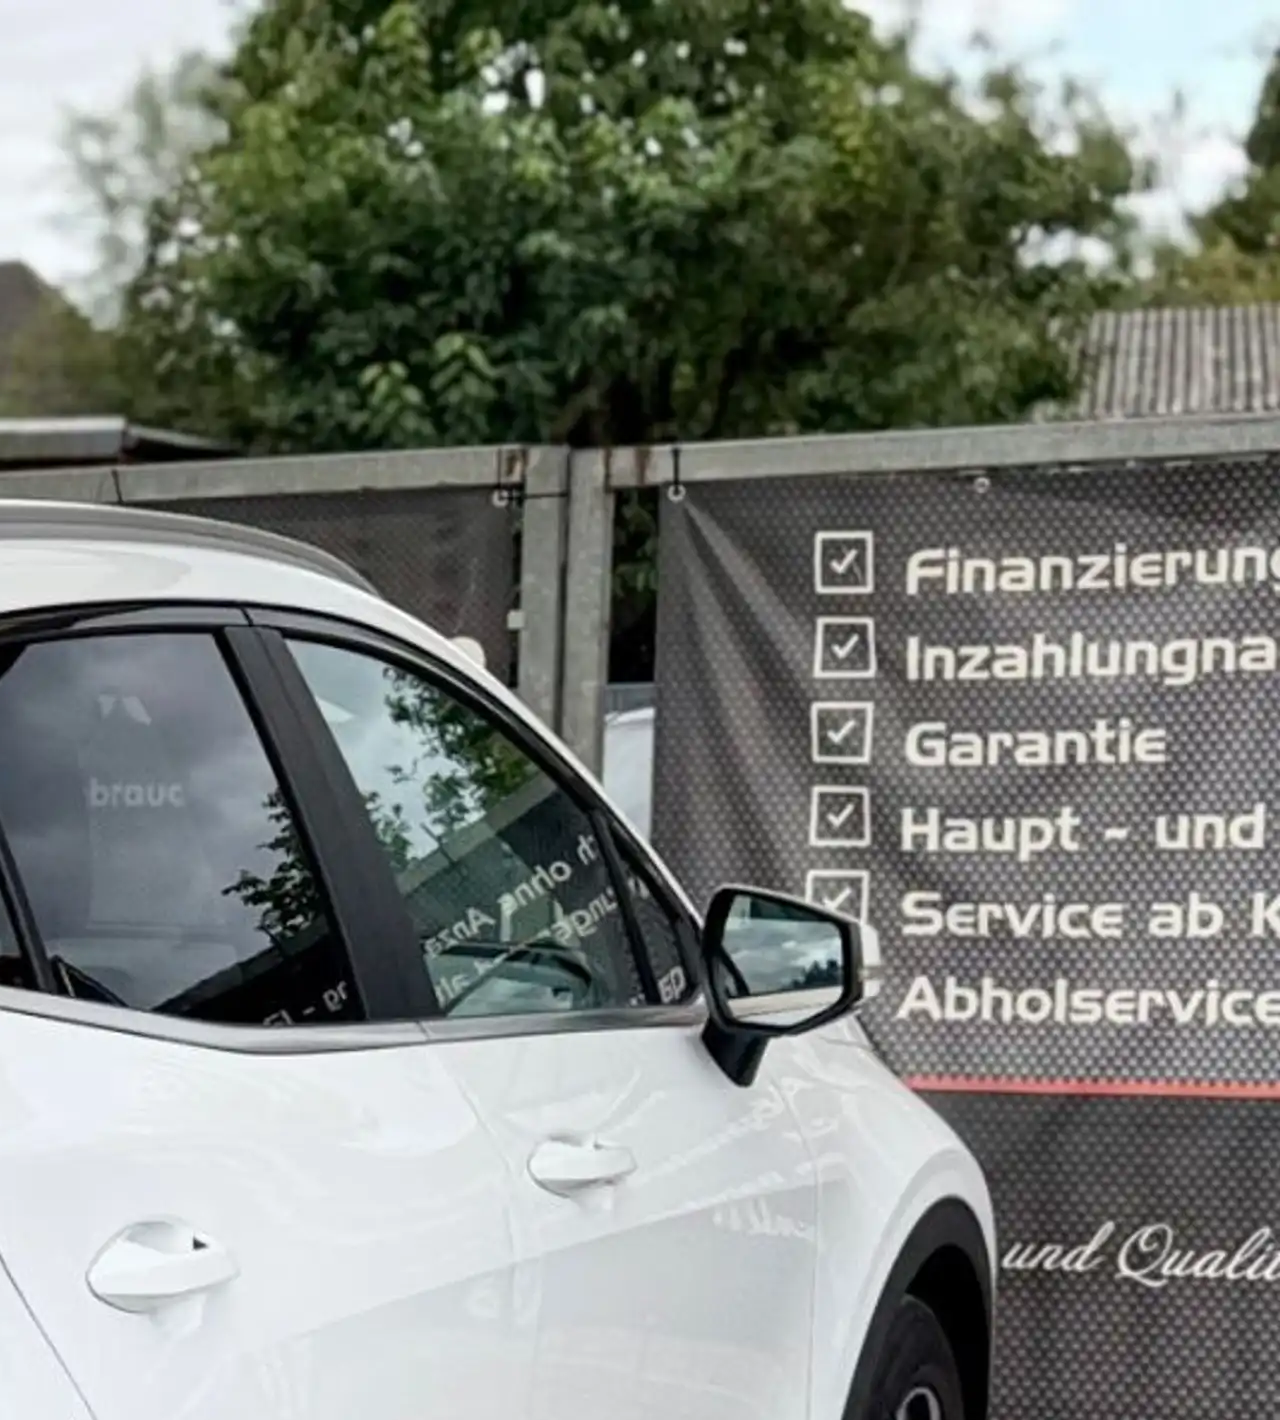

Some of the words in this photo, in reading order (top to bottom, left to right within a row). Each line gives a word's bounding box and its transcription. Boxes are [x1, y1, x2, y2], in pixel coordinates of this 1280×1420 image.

[906, 543, 1280, 595] Finanzierun
[906, 631, 1276, 685] Inzahlungna
[905, 718, 1166, 767] Garantie
[901, 807, 1080, 862] Haupt
[1155, 804, 1266, 850] und
[901, 891, 1125, 938] Service
[1148, 892, 1224, 938] ab
[896, 976, 1280, 1026] Abholservice
